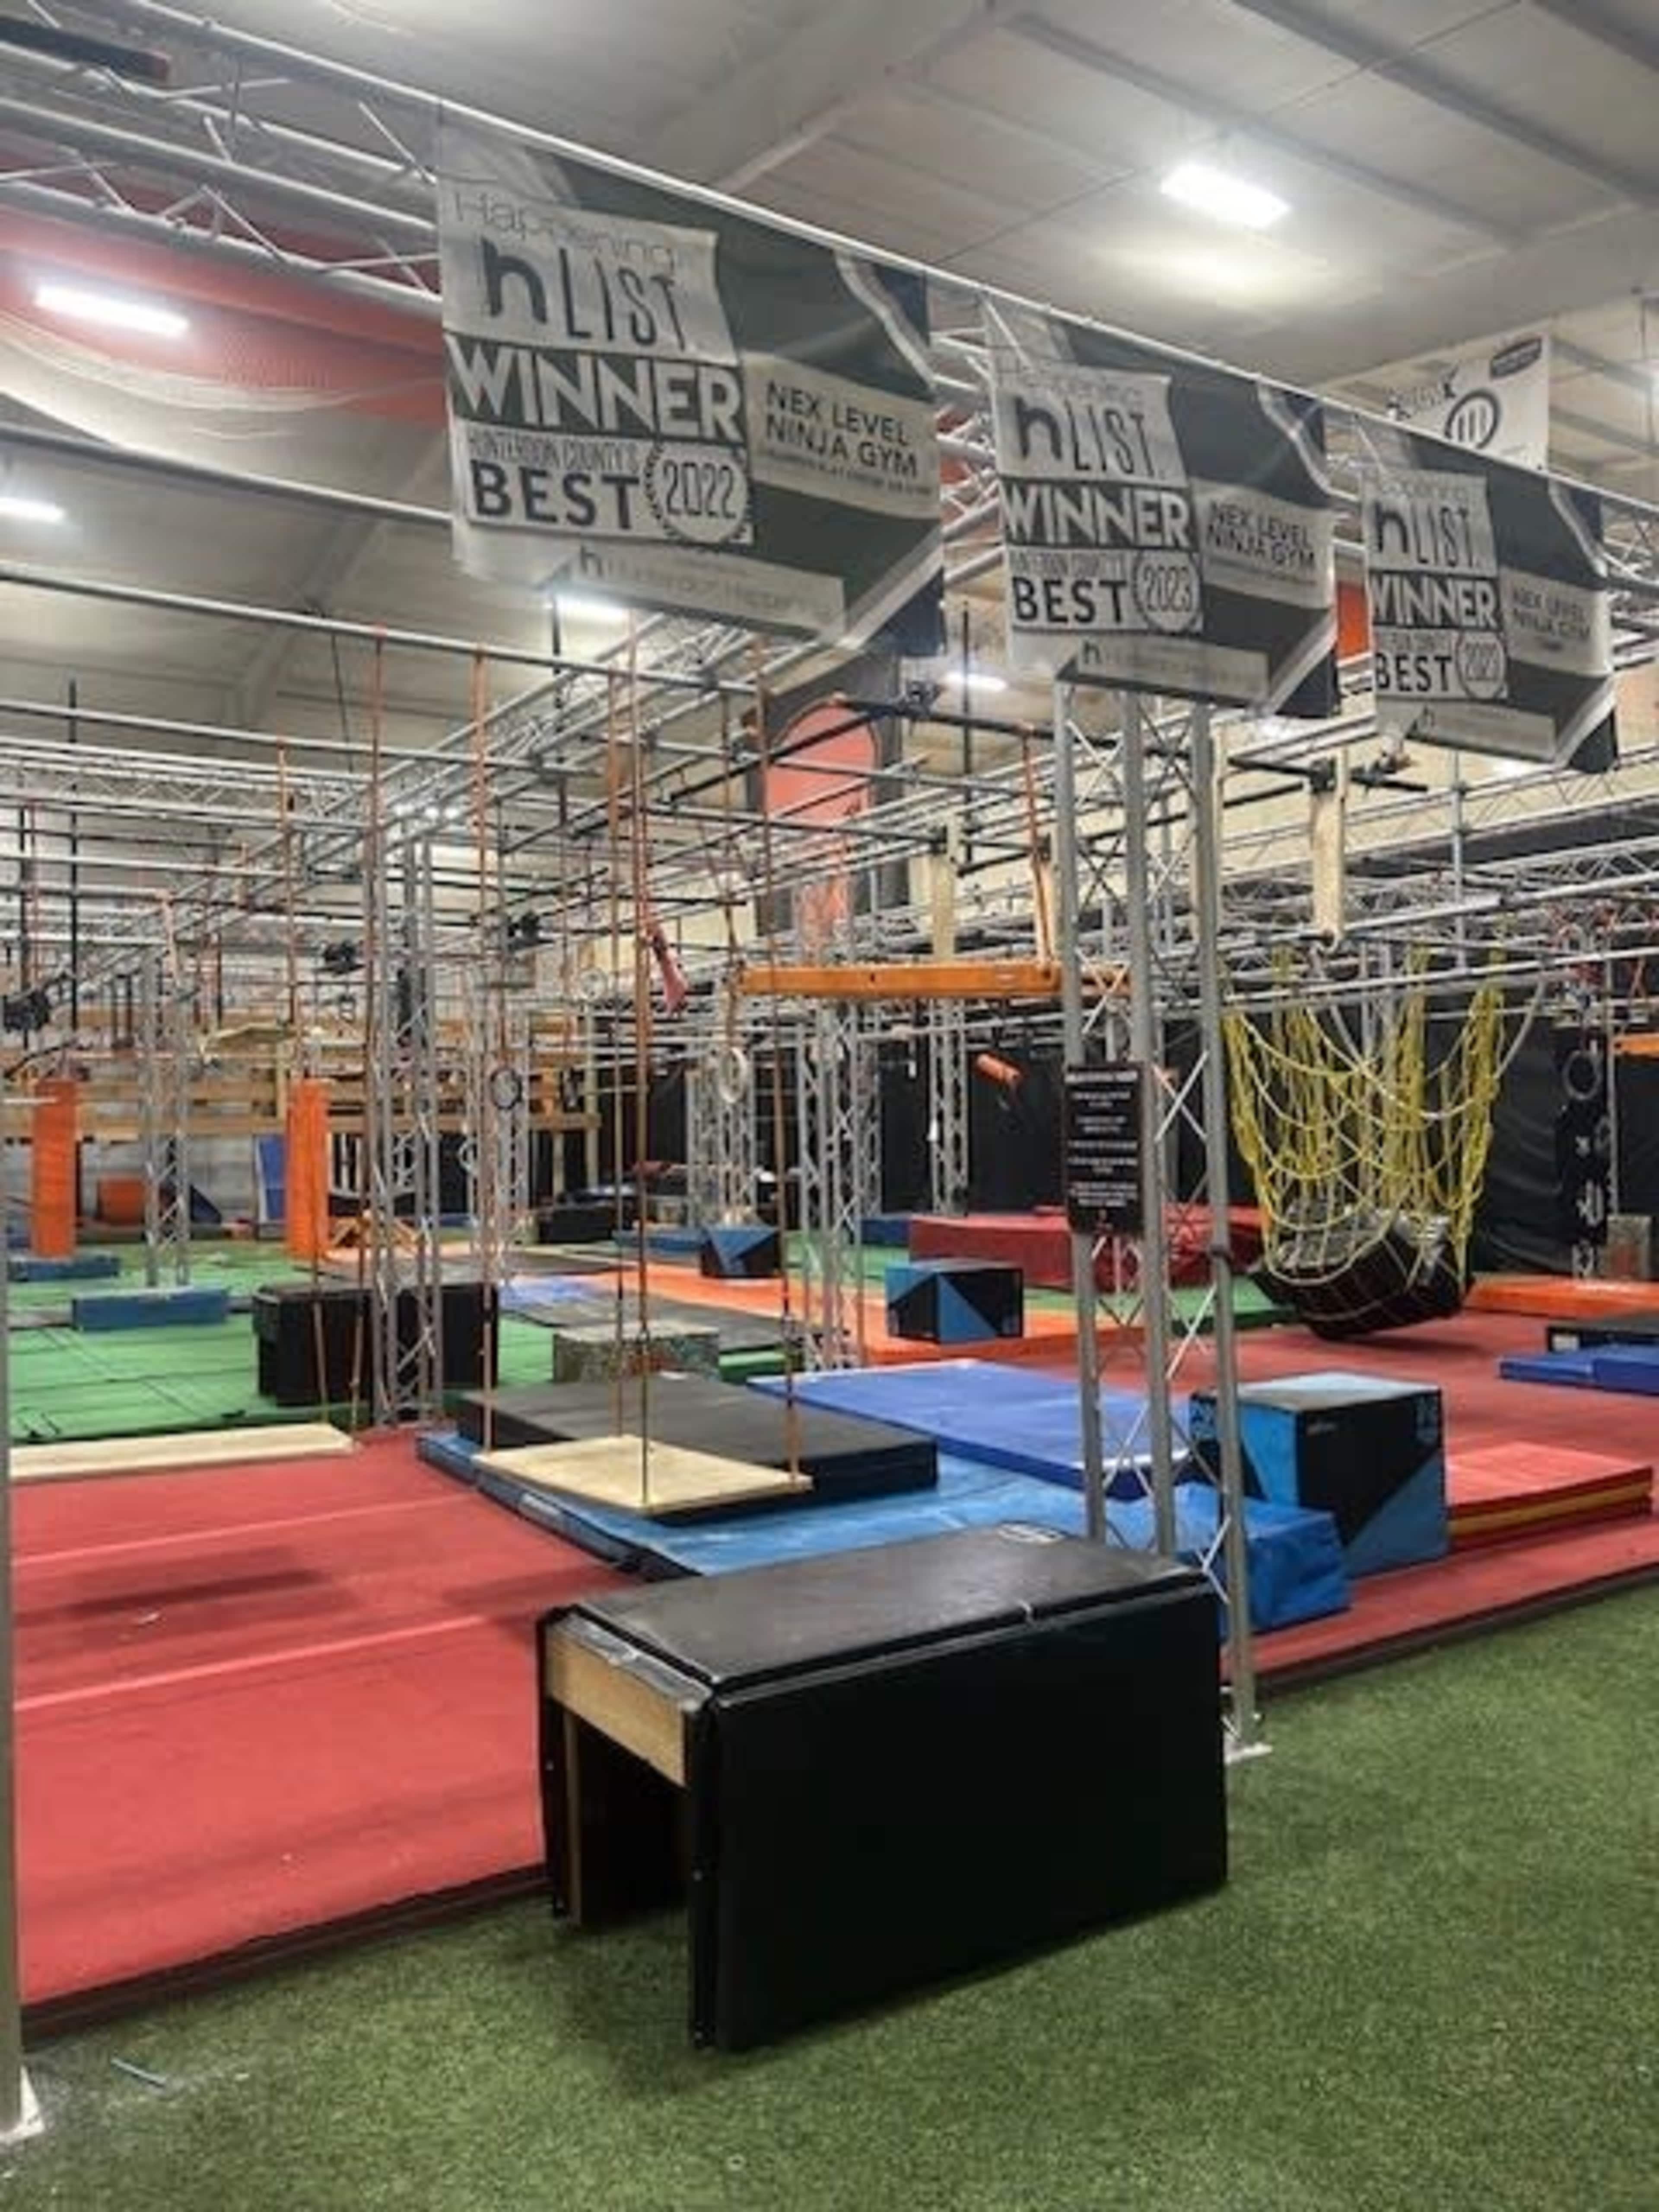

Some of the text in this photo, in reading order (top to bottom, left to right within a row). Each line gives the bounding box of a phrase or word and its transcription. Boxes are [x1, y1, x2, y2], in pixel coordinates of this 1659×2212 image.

[454, 191, 675, 271] Hapning
[559, 247, 686, 351] LIST
[443, 334, 745, 442] WINNER
[766, 379, 909, 447] NEX LEVEL
[766, 413, 849, 460] NINJA
[858, 441, 917, 477] GYM
[1064, 398, 1154, 477] LIST
[470, 458, 640, 530] BEST
[663, 459, 737, 519] 2022
[997, 480, 1192, 547] WINNER
[1258, 513, 1314, 549] LEVEL
[1272, 542, 1316, 569] GYM
[1409, 501, 1474, 568] LIST
[1012, 576, 1127, 624] BEST
[1375, 652, 1452, 692] BEST
